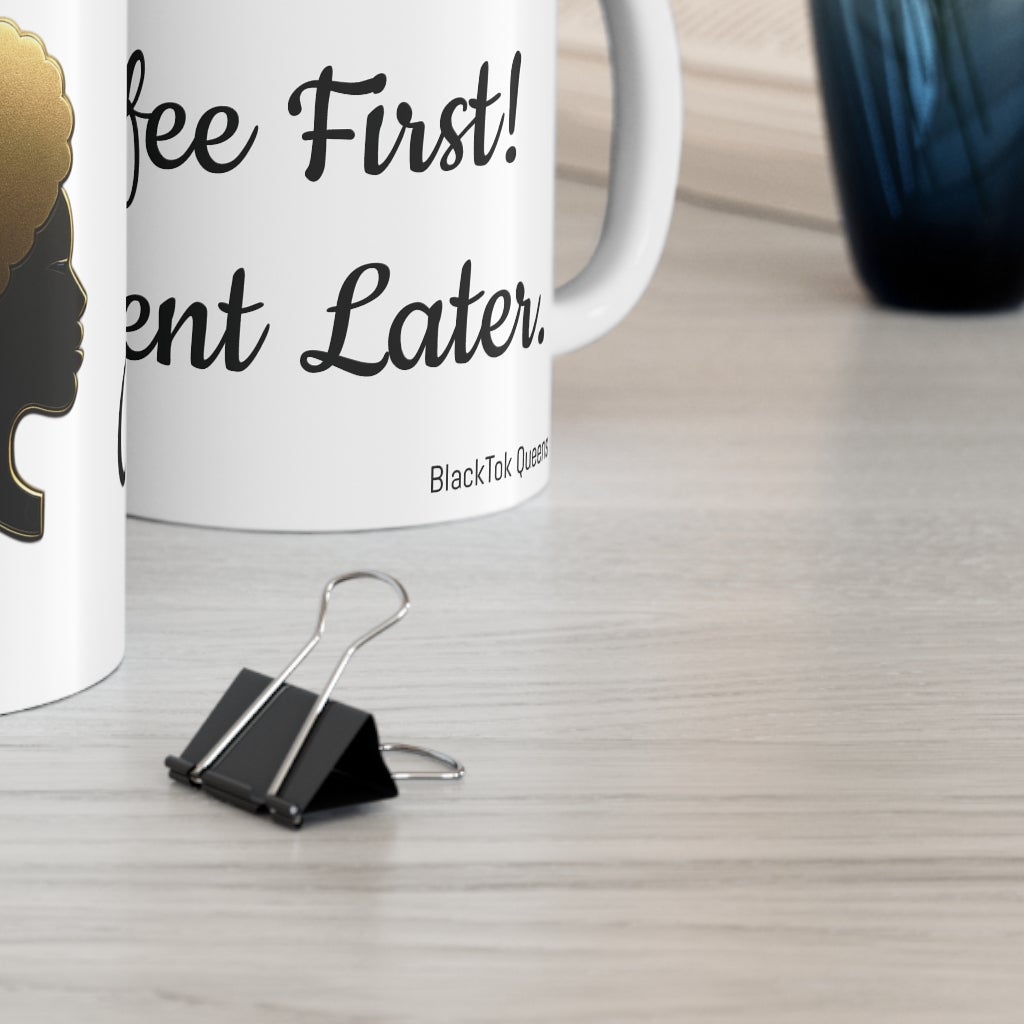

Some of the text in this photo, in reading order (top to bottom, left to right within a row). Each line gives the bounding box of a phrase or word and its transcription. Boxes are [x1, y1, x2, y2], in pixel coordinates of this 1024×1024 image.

[287, 50, 522, 183] First!
[299, 259, 545, 377] Later.
[430, 437, 549, 494] BlackTok Queens
